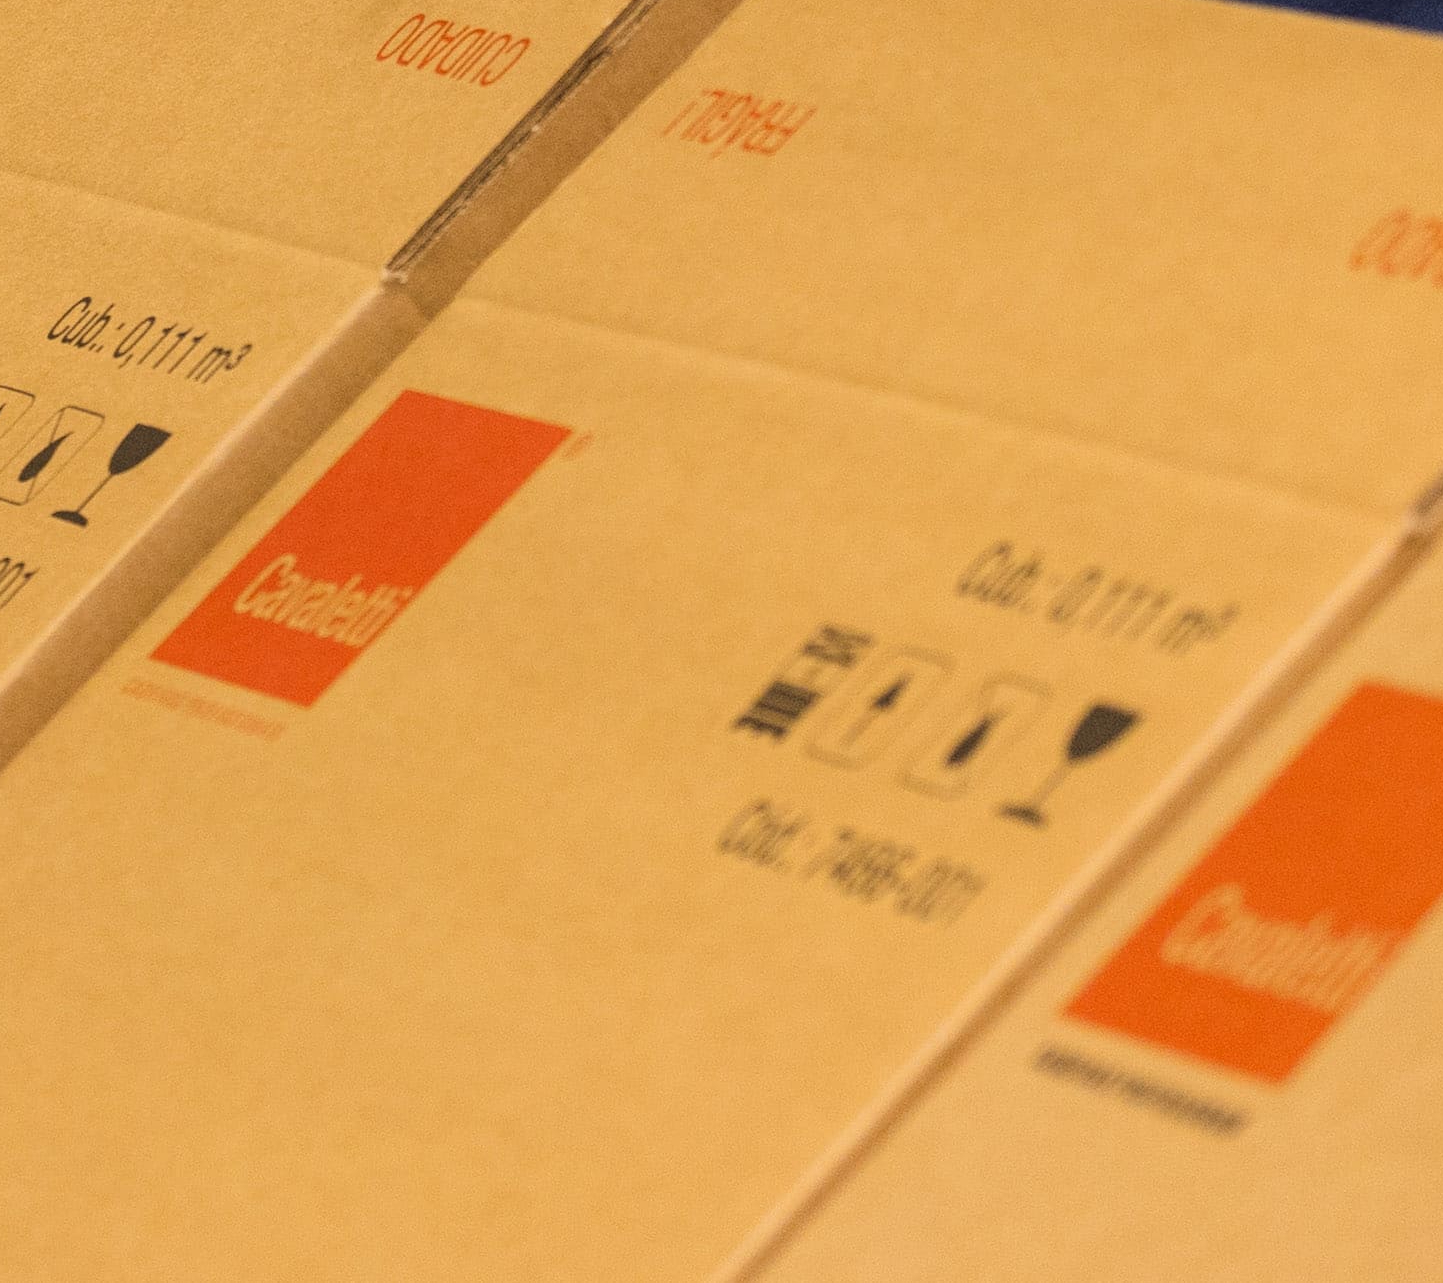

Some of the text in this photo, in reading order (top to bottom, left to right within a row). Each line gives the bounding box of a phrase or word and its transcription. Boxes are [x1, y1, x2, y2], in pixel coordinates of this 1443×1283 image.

[375, 12, 531, 87] CUIDADO
[113, 315, 209, 375] 0,111
[232, 552, 416, 650] Cavaletti
